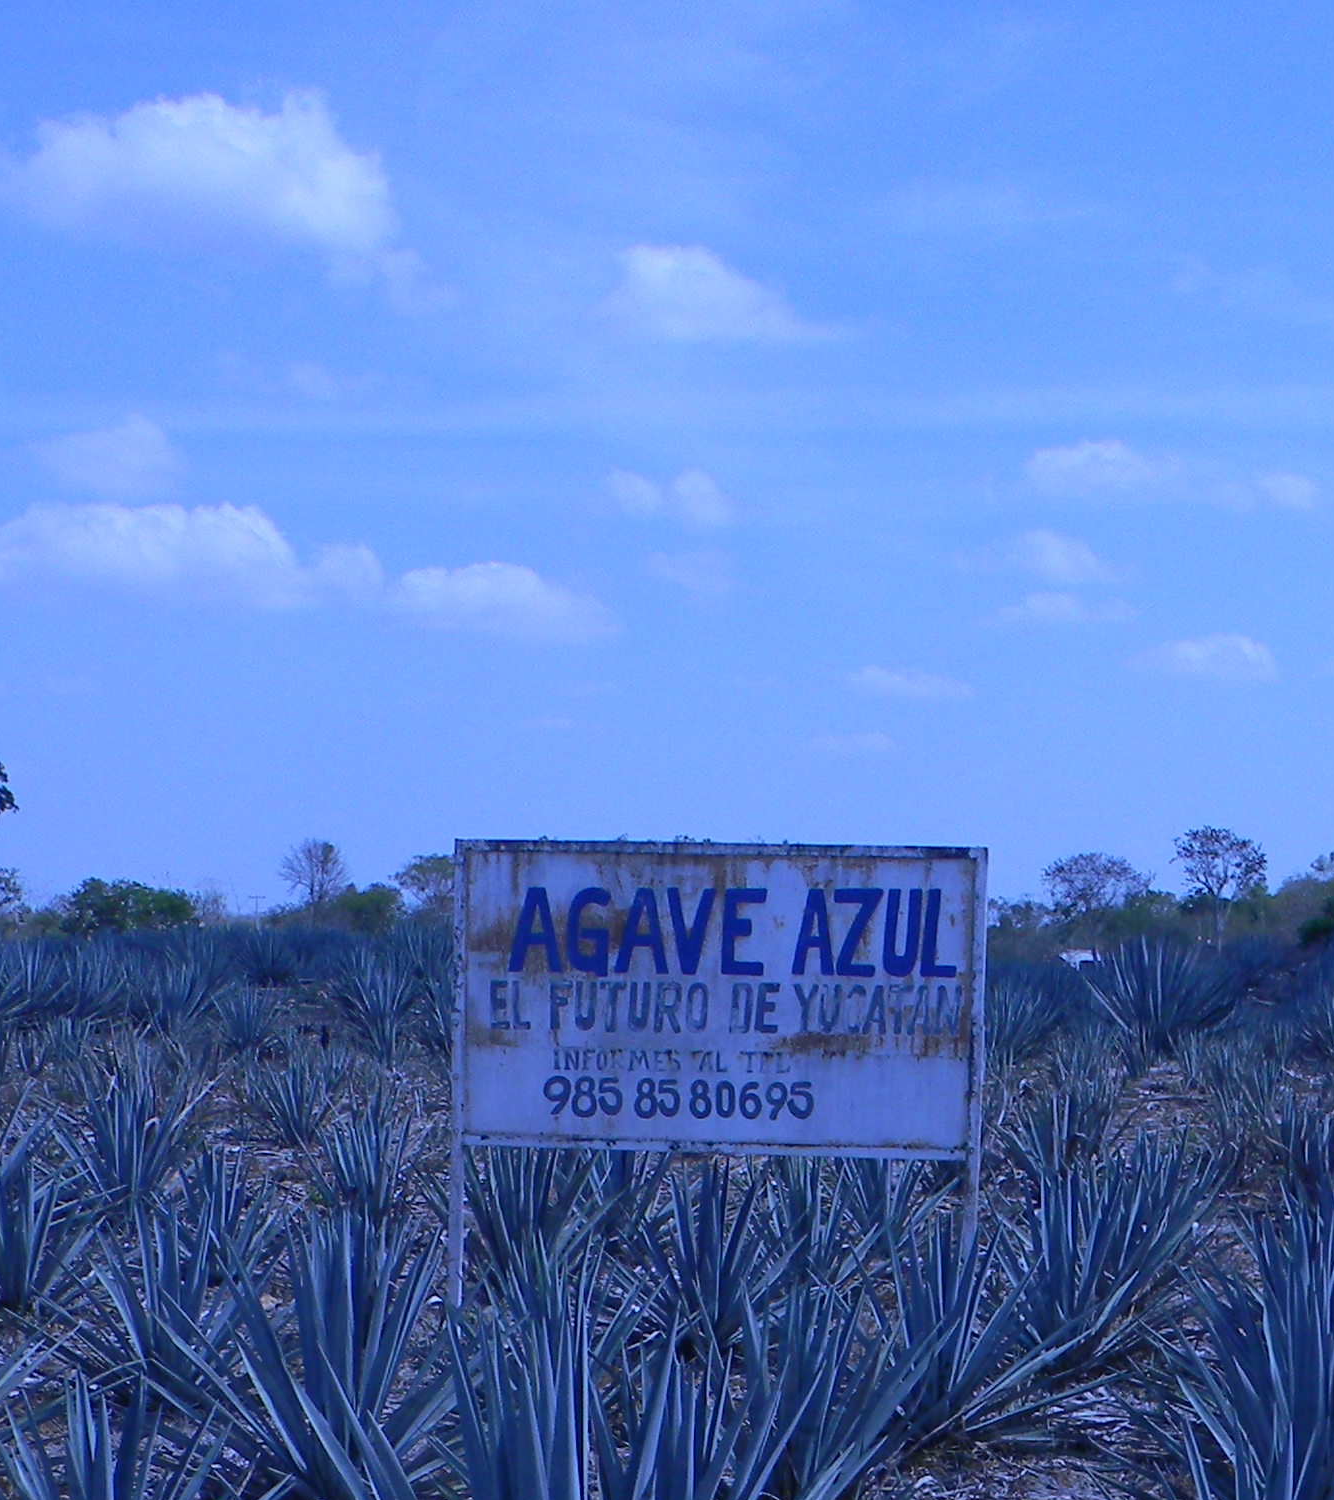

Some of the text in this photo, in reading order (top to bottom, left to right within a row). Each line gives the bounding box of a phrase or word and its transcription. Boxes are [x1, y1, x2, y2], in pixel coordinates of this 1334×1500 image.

[508, 887, 957, 977] AGAVE AZUL
[490, 980, 531, 1030] EL
[549, 980, 709, 1034] FUTURO
[729, 982, 780, 1034] DE
[553, 1048, 681, 1073] INFORMES
[691, 1050, 727, 1073] AL
[543, 1076, 623, 1118] 985
